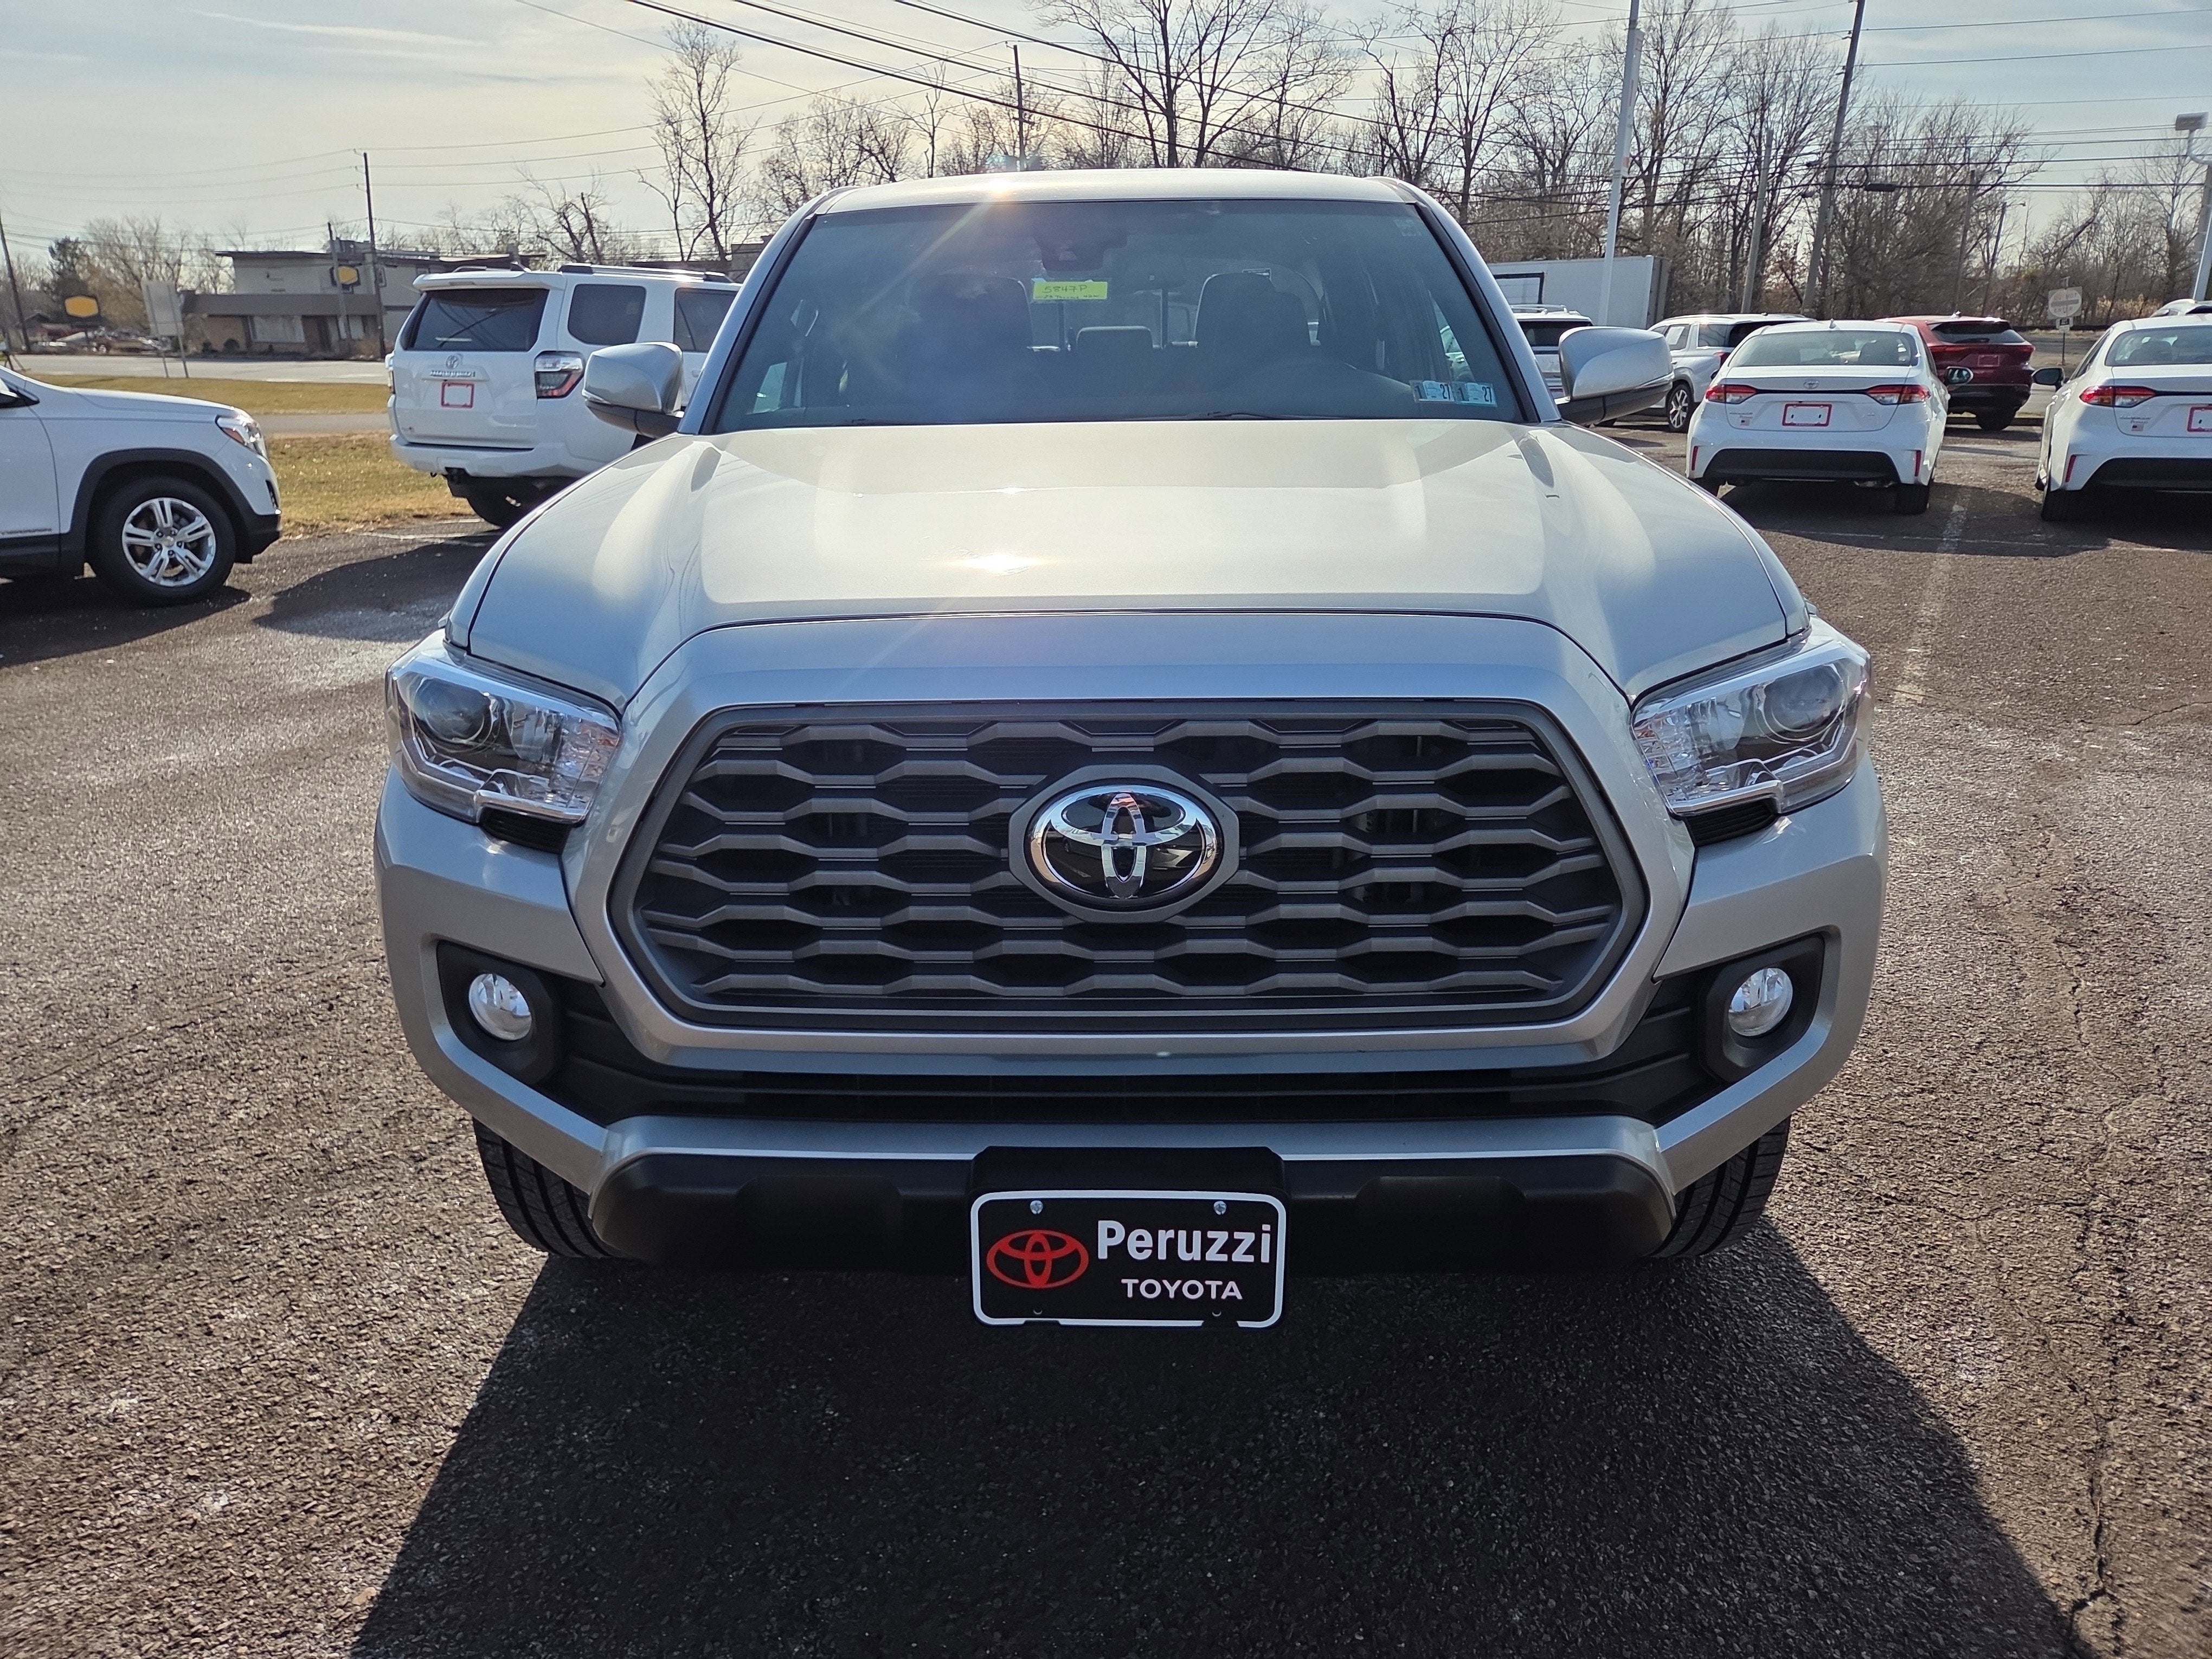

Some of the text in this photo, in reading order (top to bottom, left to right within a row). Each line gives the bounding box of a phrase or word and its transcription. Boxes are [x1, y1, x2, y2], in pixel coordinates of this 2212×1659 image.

[1042, 285, 1088, 293] 5847P
[1440, 384, 1451, 400] 27
[1482, 386, 1493, 402] 27
[1098, 1220, 1271, 1263] Peruzzi
[1121, 1279, 1243, 1300] TOYOTA
